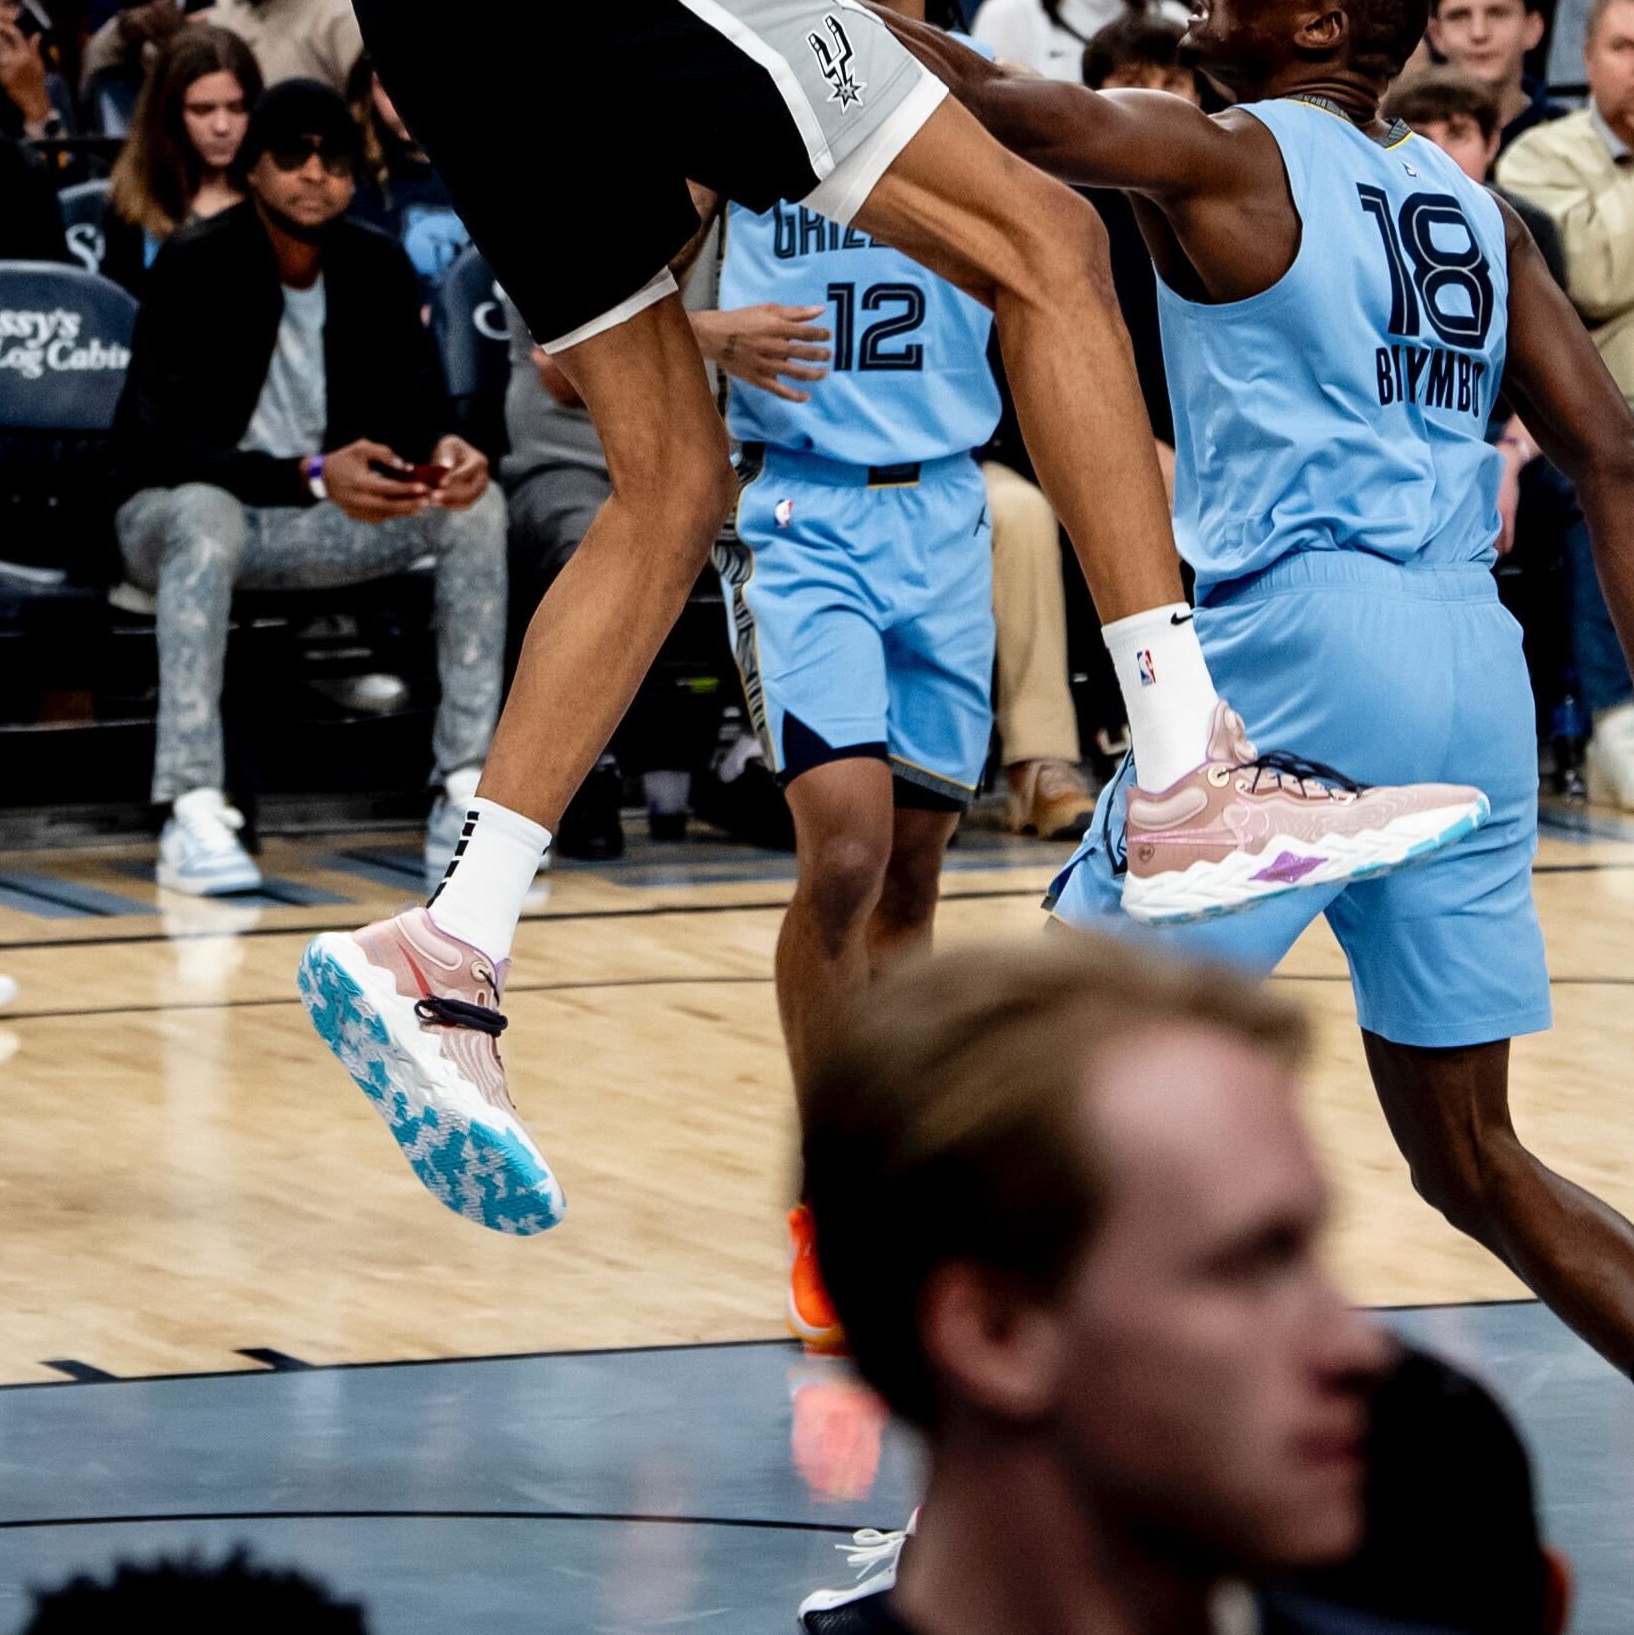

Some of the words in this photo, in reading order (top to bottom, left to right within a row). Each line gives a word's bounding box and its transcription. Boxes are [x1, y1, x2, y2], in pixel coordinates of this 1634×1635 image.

[1356, 182, 1494, 350] 18
[827, 282, 926, 372] 12
[1376, 344, 1485, 419] BIYMBO
